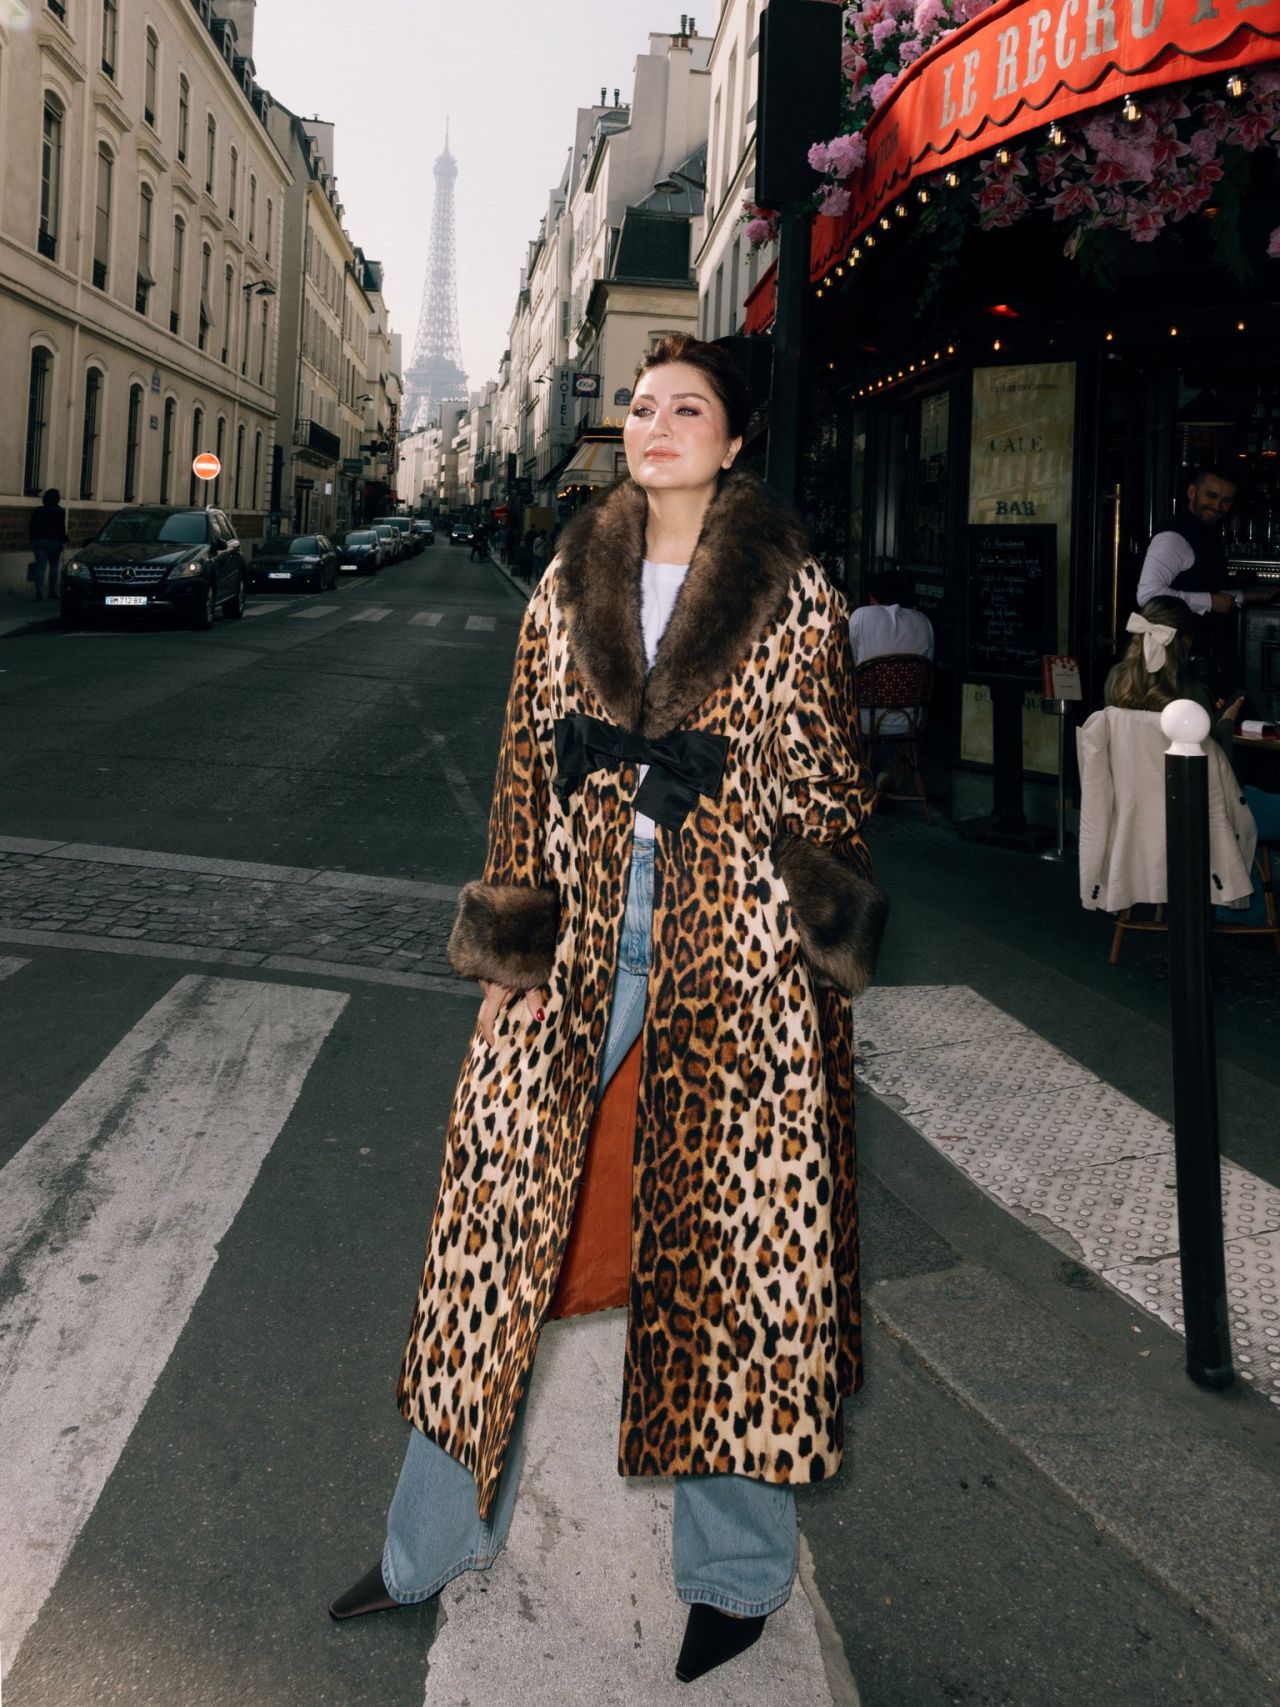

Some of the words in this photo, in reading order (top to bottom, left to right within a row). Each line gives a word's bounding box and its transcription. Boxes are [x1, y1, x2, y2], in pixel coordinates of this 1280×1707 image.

[939, 48, 981, 130] LE
[992, 0, 1271, 101] RECRU
[560, 371, 568, 426] HOTEL
[996, 501, 1036, 516] BAR
